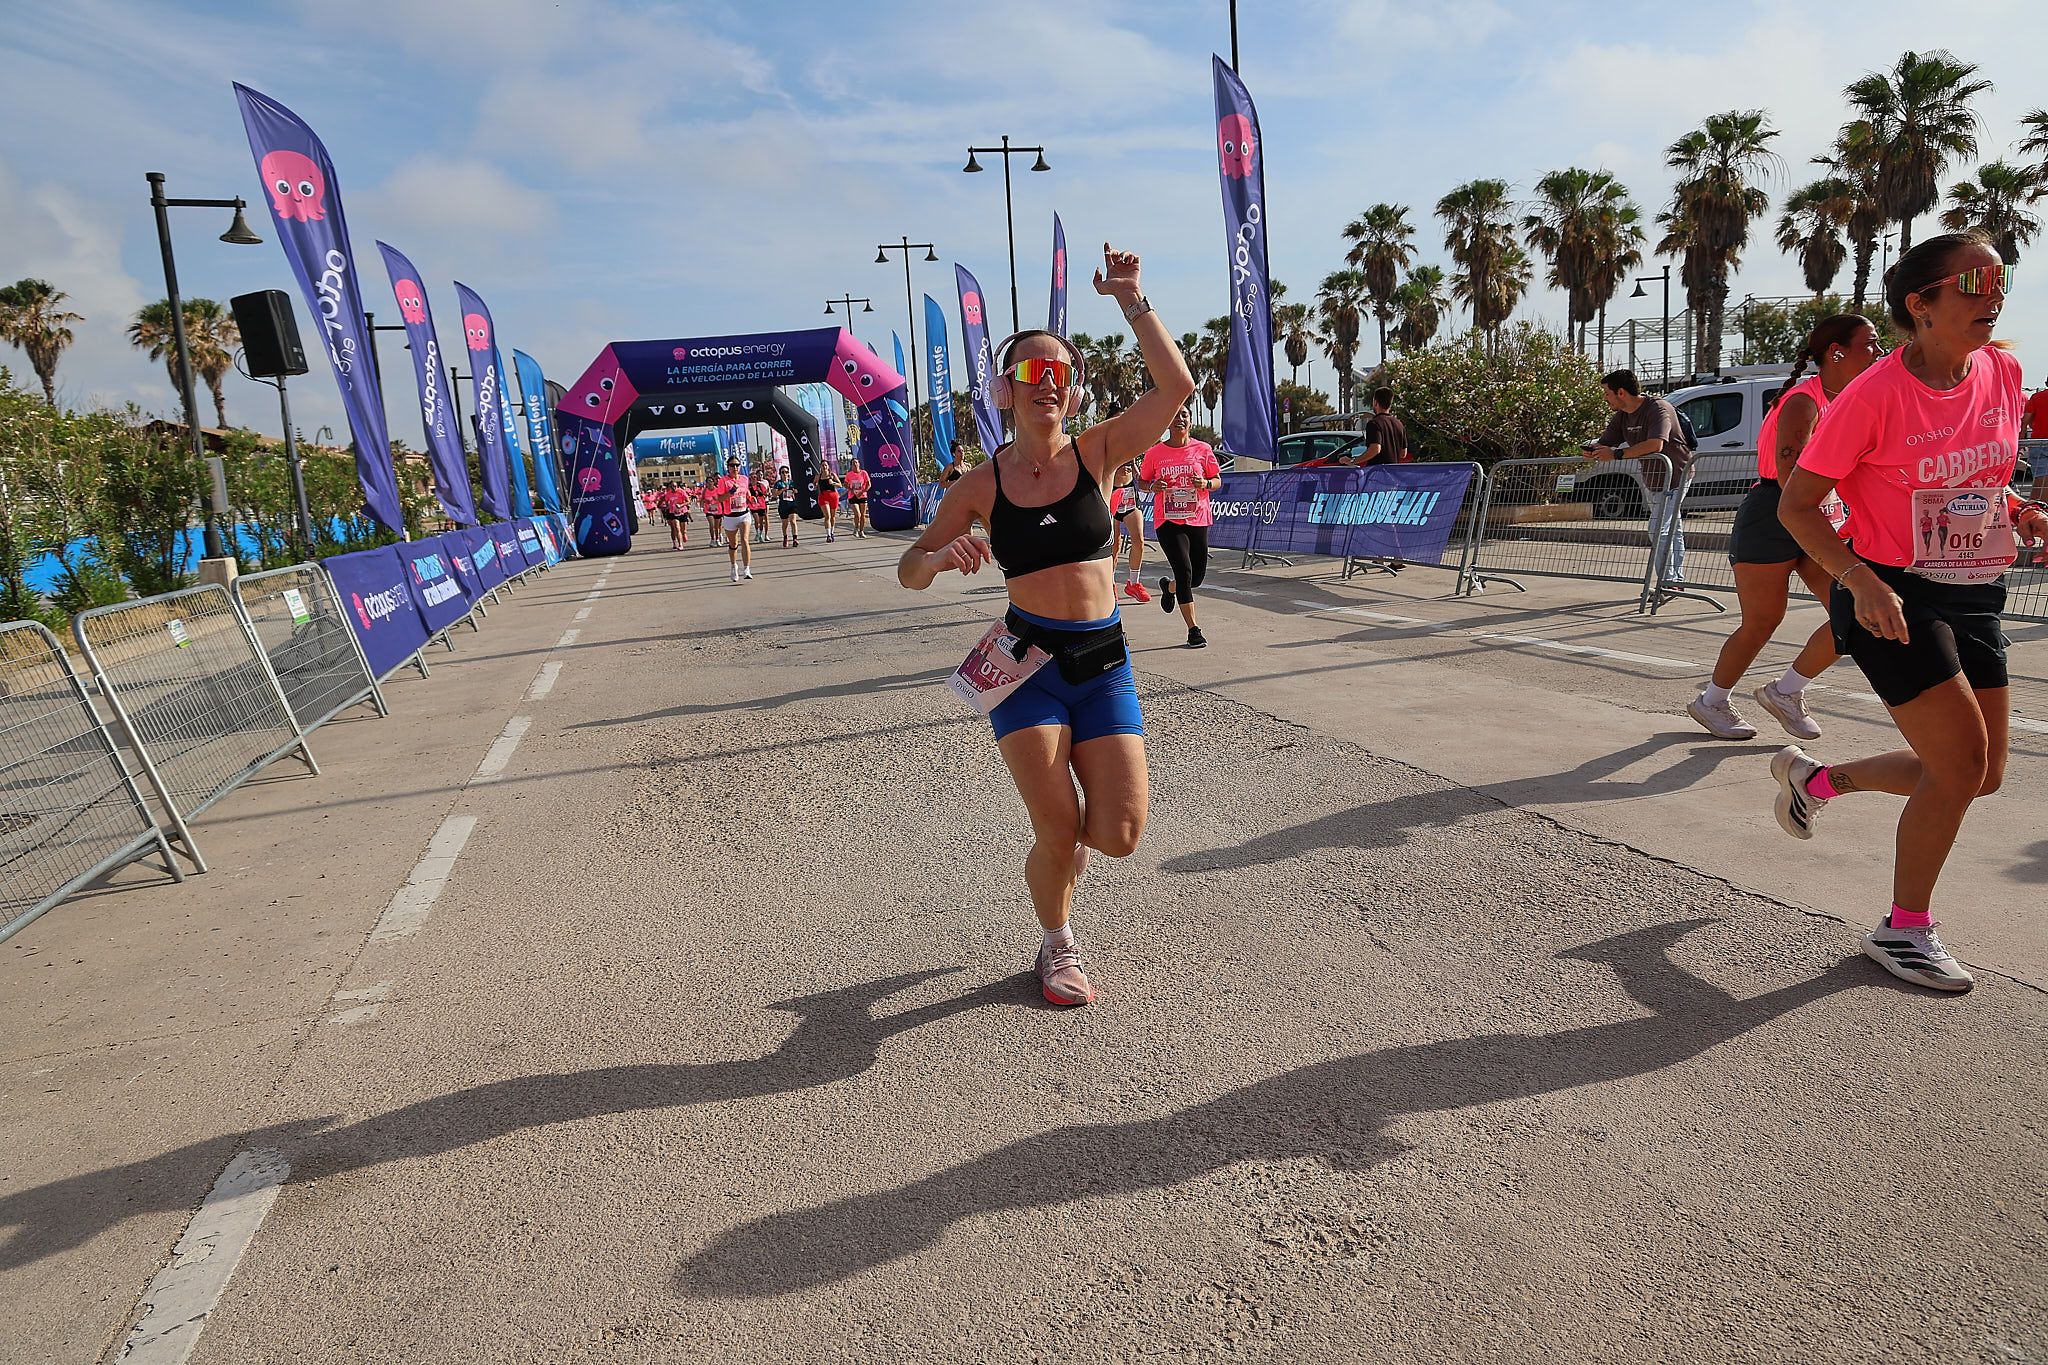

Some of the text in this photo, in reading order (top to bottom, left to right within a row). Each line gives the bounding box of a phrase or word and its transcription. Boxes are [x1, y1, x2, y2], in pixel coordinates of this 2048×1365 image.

[690, 343, 786, 358] octopus energy
[667, 360, 792, 375] LA ENERGÍA PARA CORRER
[691, 373, 746, 383] VELOCIDAD
[776, 369, 795, 377] LUZ
[648, 399, 754, 416] VOLVO
[1906, 426, 1954, 446] OYSHO
[1918, 438, 2013, 485] CARRERA
[801, 435, 818, 509] VOLVO
[1161, 465, 1193, 477] CARRERA
[1179, 476, 1190, 487] DE
[1209, 498, 1281, 524] topus energy
[1307, 491, 1441, 526] ¡ENHORABUENA!
[1819, 504, 1835, 515] 16
[1949, 533, 1983, 549] 016
[1958, 551, 1974, 559] 4143
[1979, 558, 2006, 566] VALENCIA
[1919, 571, 1956, 580] OYSHO
[981, 661, 1012, 687] 016
[955, 680, 975, 699] OYSHO
